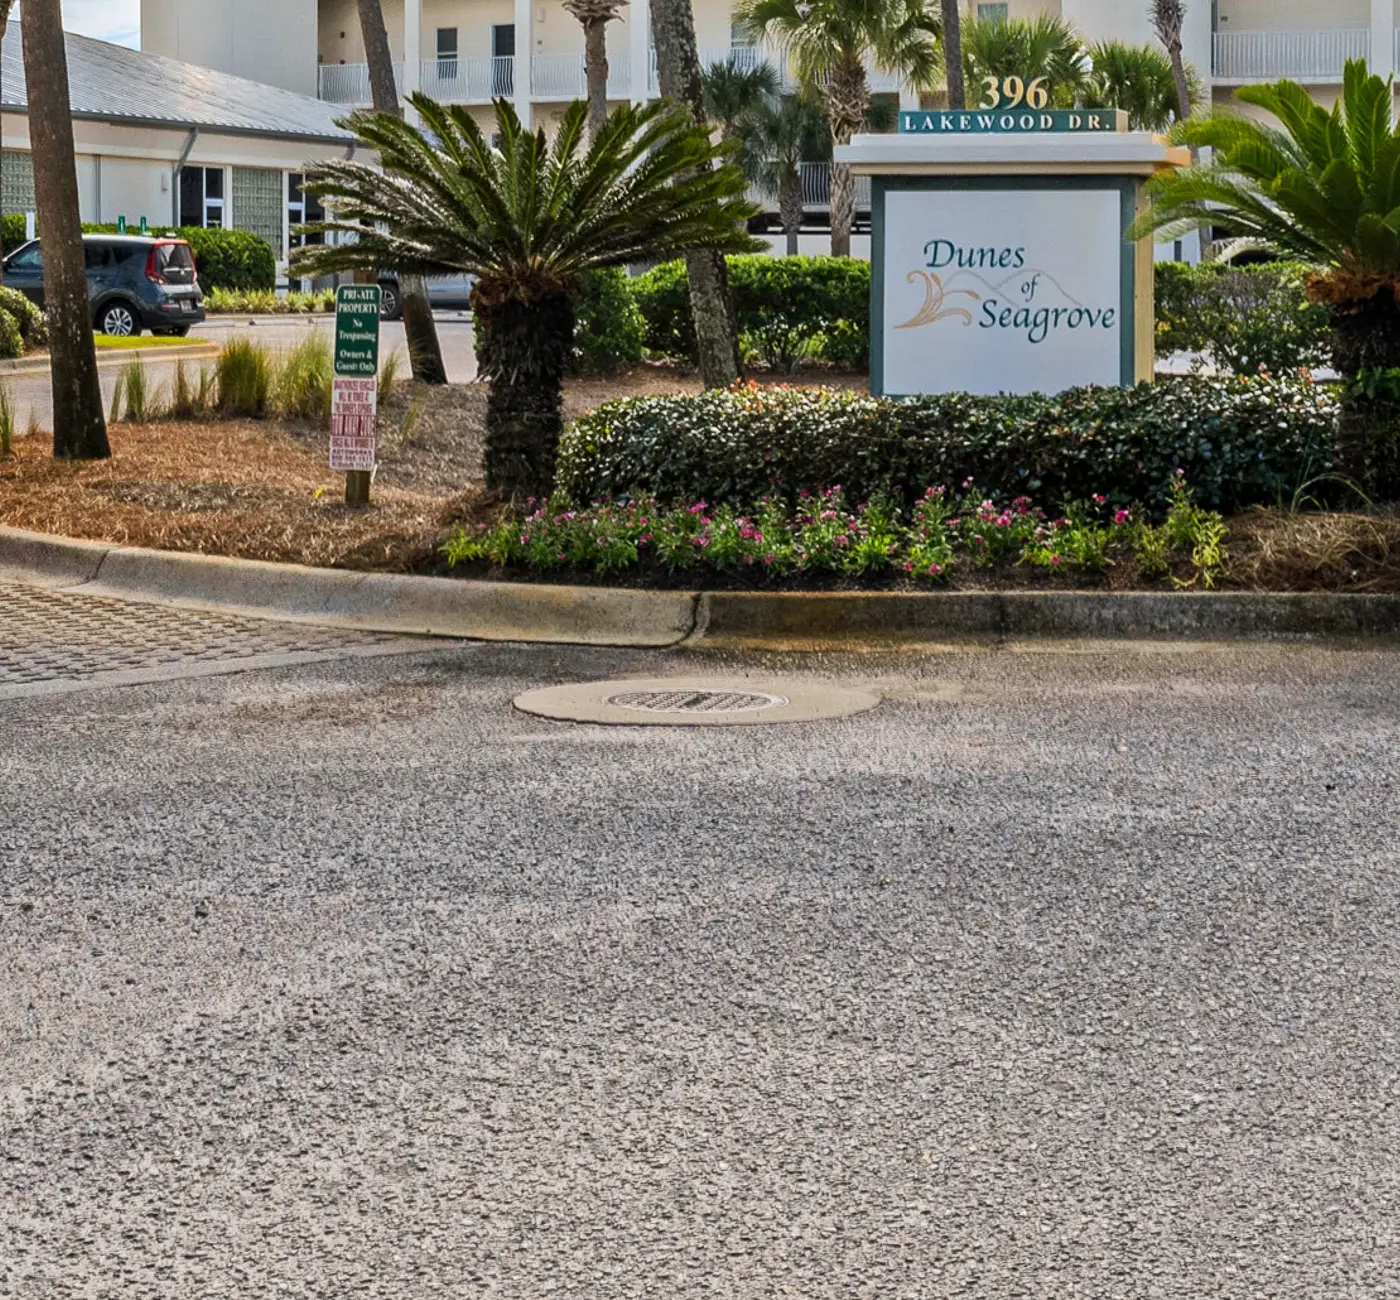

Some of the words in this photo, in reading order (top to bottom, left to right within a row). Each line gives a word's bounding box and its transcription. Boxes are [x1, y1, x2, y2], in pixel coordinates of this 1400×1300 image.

[978, 75, 1049, 110] 396
[904, 114, 1053, 130] LAKEWOOD
[1069, 114, 1111, 130] DR.
[923, 239, 1026, 268] Dunes
[1020, 273, 1041, 303] of
[338, 303, 378, 314] PROPERTY
[352, 318, 363, 328] No
[978, 299, 1115, 344] Seagrove
[339, 330, 377, 342] Trespassing
[340, 350, 365, 359] Owners
[359, 362, 376, 373] Only
